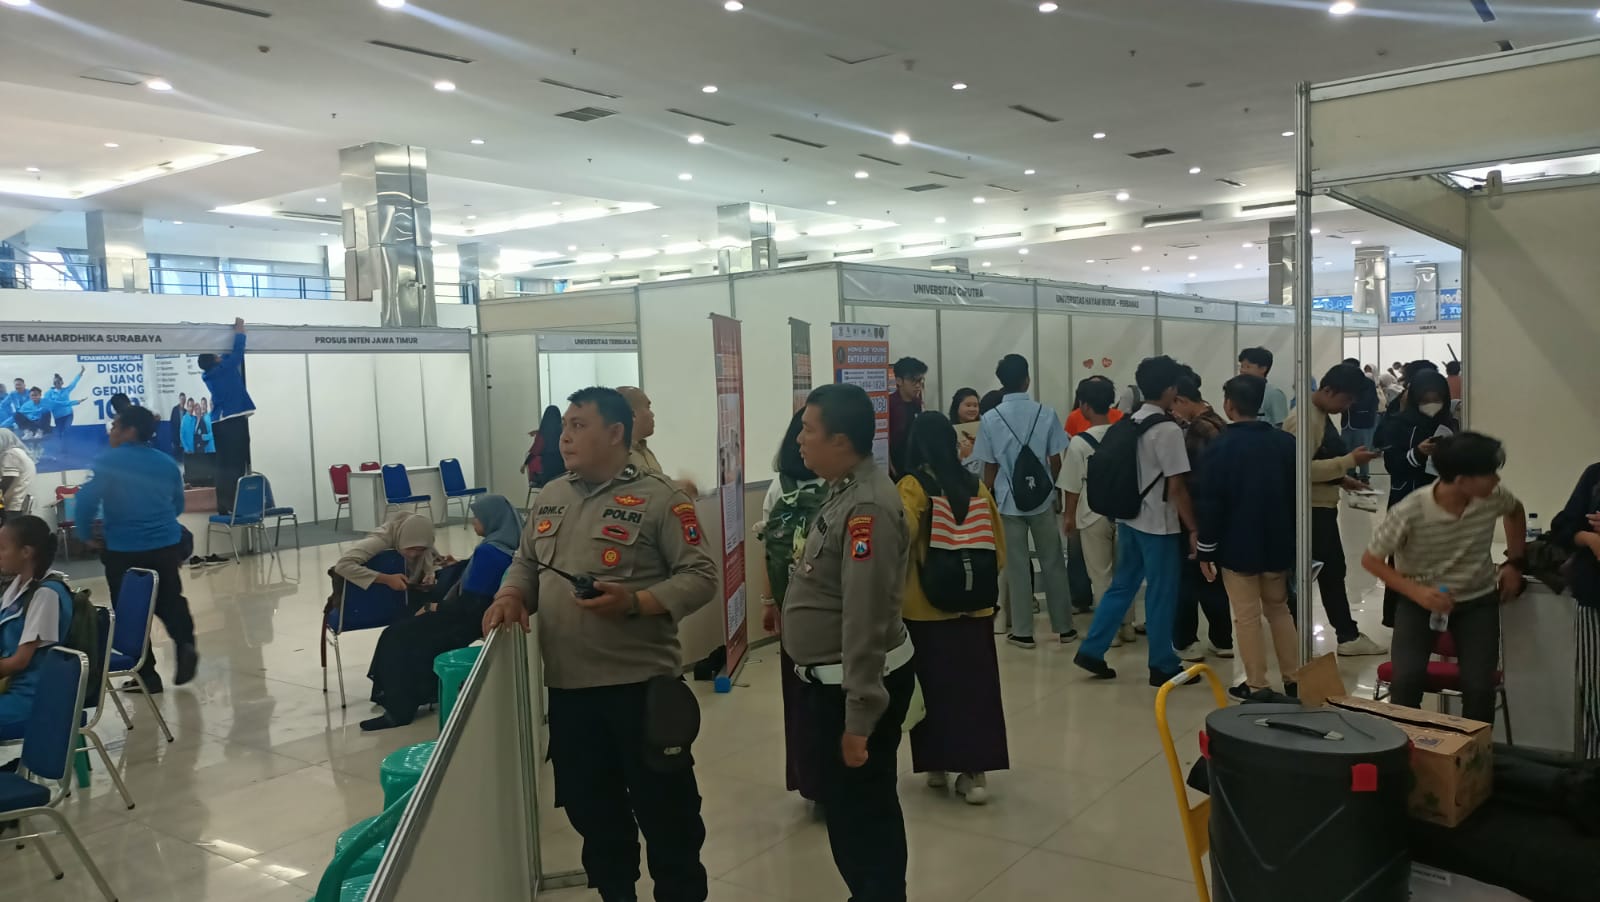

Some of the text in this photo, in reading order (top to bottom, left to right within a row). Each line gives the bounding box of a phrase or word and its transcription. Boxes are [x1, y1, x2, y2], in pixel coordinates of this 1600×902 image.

[912, 284, 957, 296] UNIVERSITAS
[1056, 294, 1085, 305] UNIVERSITAS
[0, 333, 162, 343] STIE MAHARDHIKA SURABAYA
[314, 336, 419, 345] PROSUS INTEN JAWA TIMUR
[97, 363, 143, 374] DISKON
[110, 374, 144, 385] UANG
[92, 385, 145, 397] GEDUNG
[602, 508, 643, 524] POLRI
